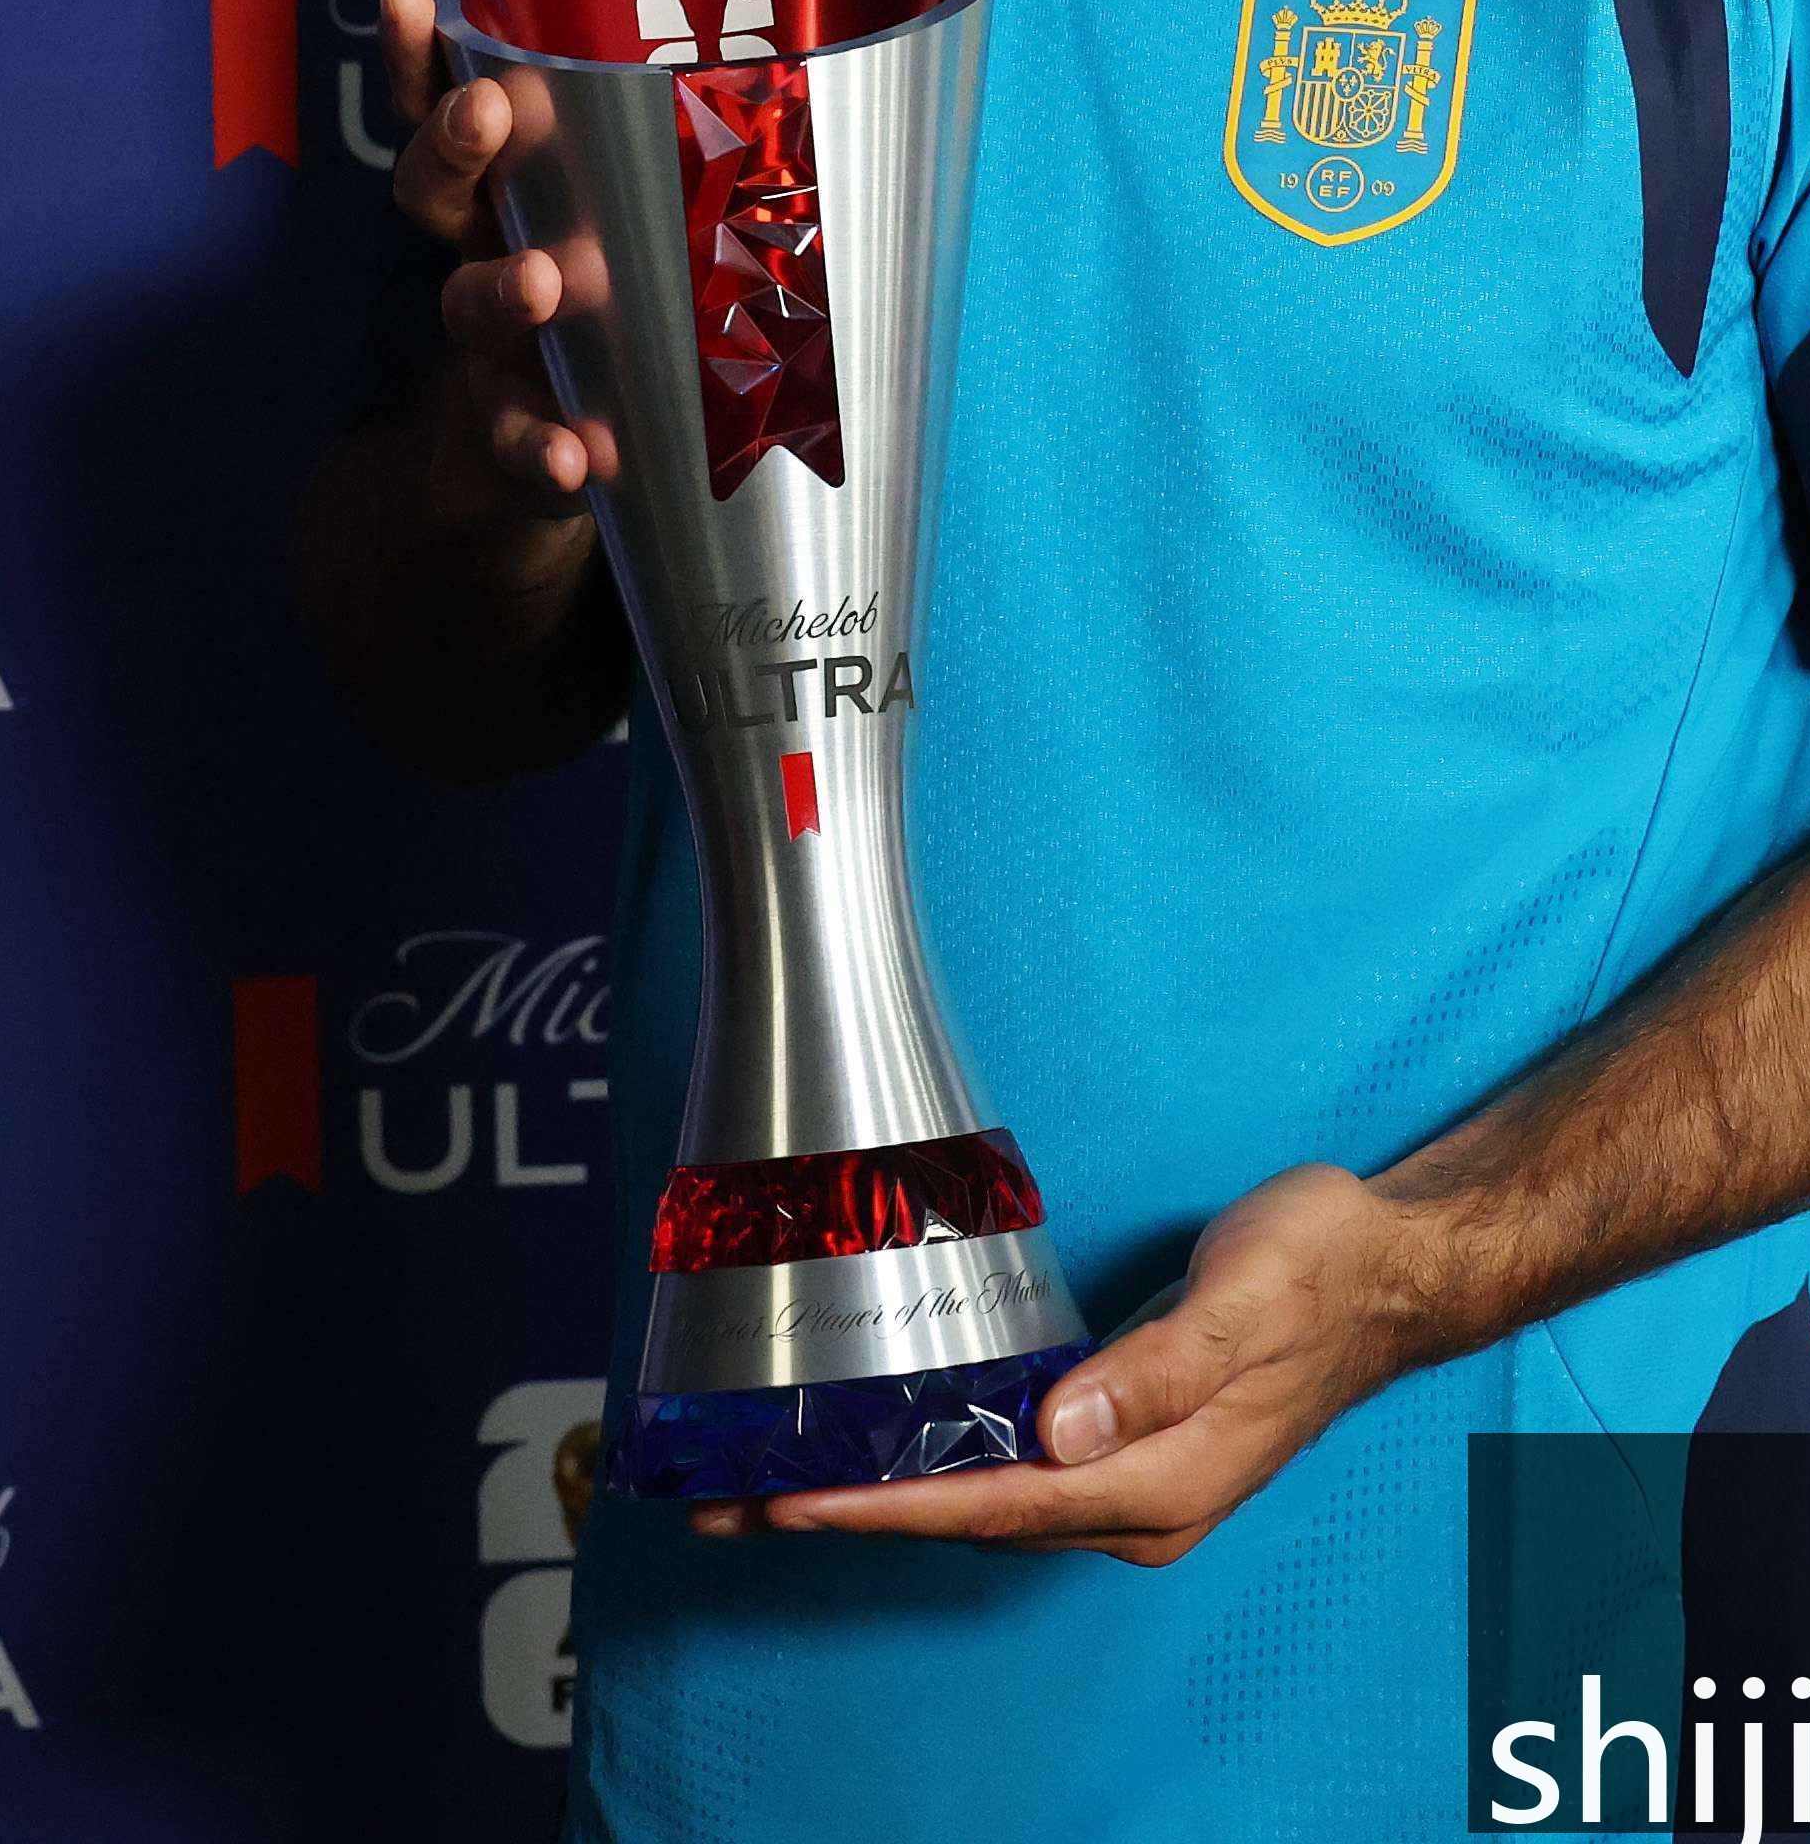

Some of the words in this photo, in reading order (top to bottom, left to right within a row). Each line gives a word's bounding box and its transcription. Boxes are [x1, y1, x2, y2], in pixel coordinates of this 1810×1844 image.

[1279, 172, 1299, 189] 19
[1319, 168, 1352, 183] RF
[1319, 184, 1350, 199] EF
[1370, 181, 1396, 197] 09
[768, 1297, 884, 1343] Player
[886, 1286, 932, 1337] of
[929, 1285, 971, 1319] the
[976, 1269, 1053, 1316] Match
